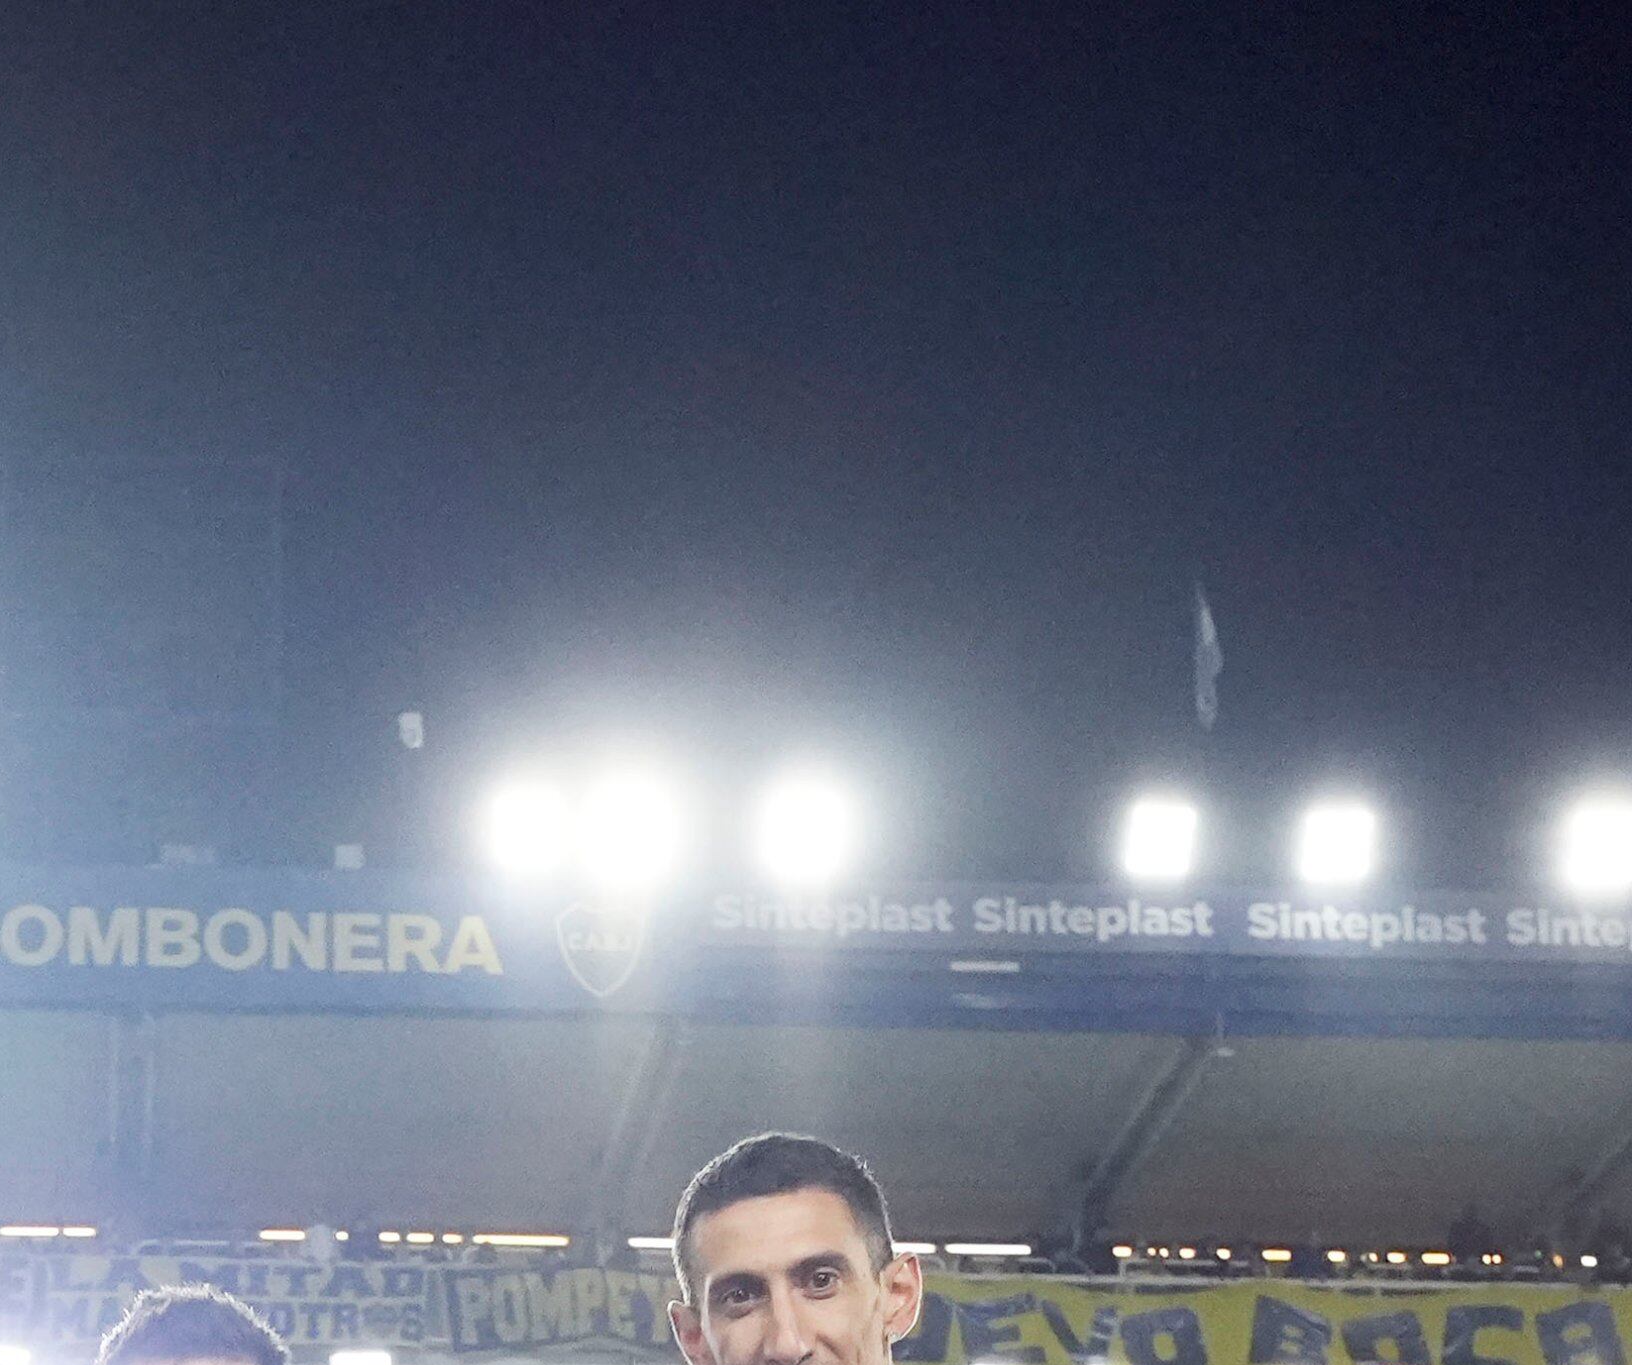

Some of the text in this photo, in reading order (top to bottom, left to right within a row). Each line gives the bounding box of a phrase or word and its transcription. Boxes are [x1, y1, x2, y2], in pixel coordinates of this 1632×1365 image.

[713, 894, 1632, 952] Sinteplast Sinteplast Sinteplast Sinte
